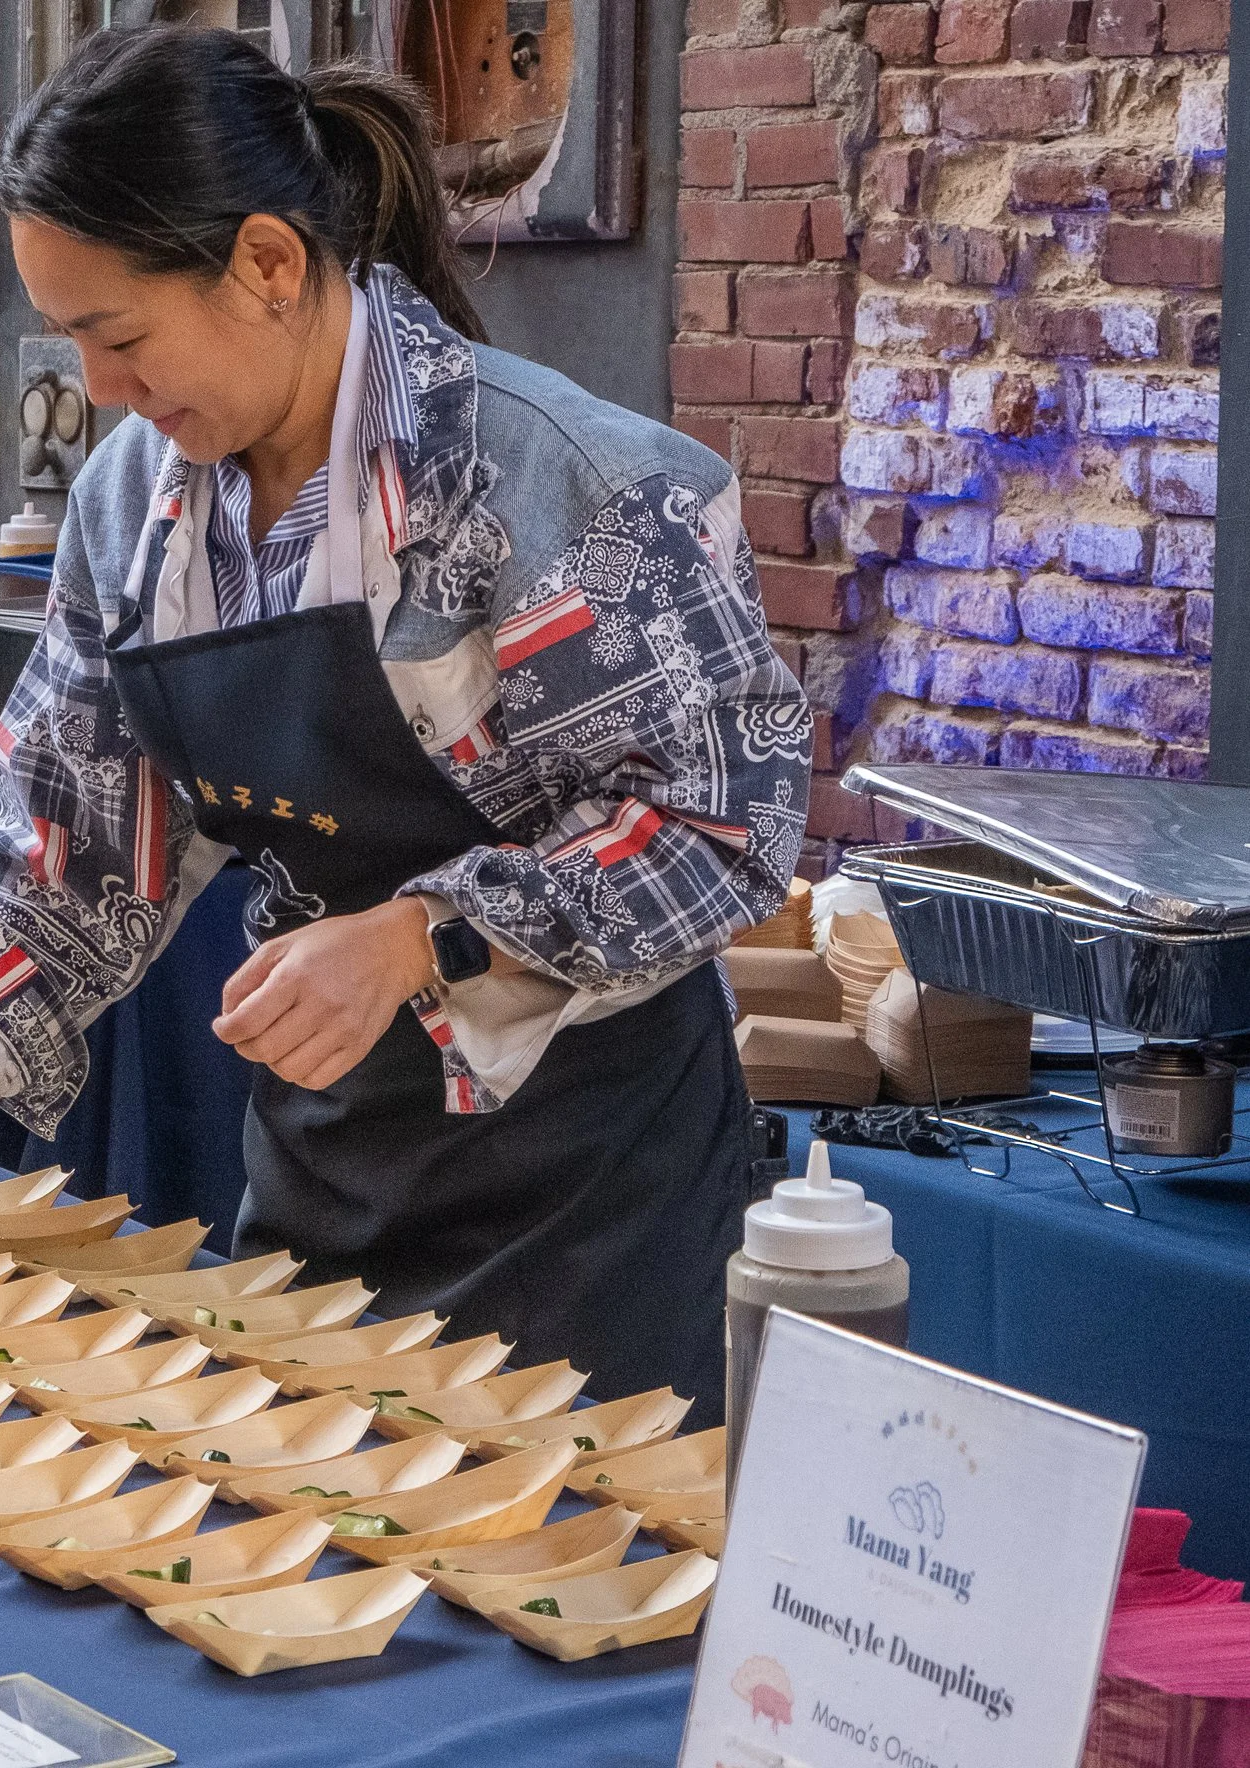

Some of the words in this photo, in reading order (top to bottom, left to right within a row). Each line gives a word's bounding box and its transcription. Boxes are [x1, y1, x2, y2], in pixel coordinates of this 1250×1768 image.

[844, 1514, 910, 1569] Mama
[918, 1543, 976, 1605] Yang
[771, 1581, 885, 1657] Homestyle
[888, 1635, 1015, 1721] Dumplings
[811, 1700, 879, 1753] Mama's
